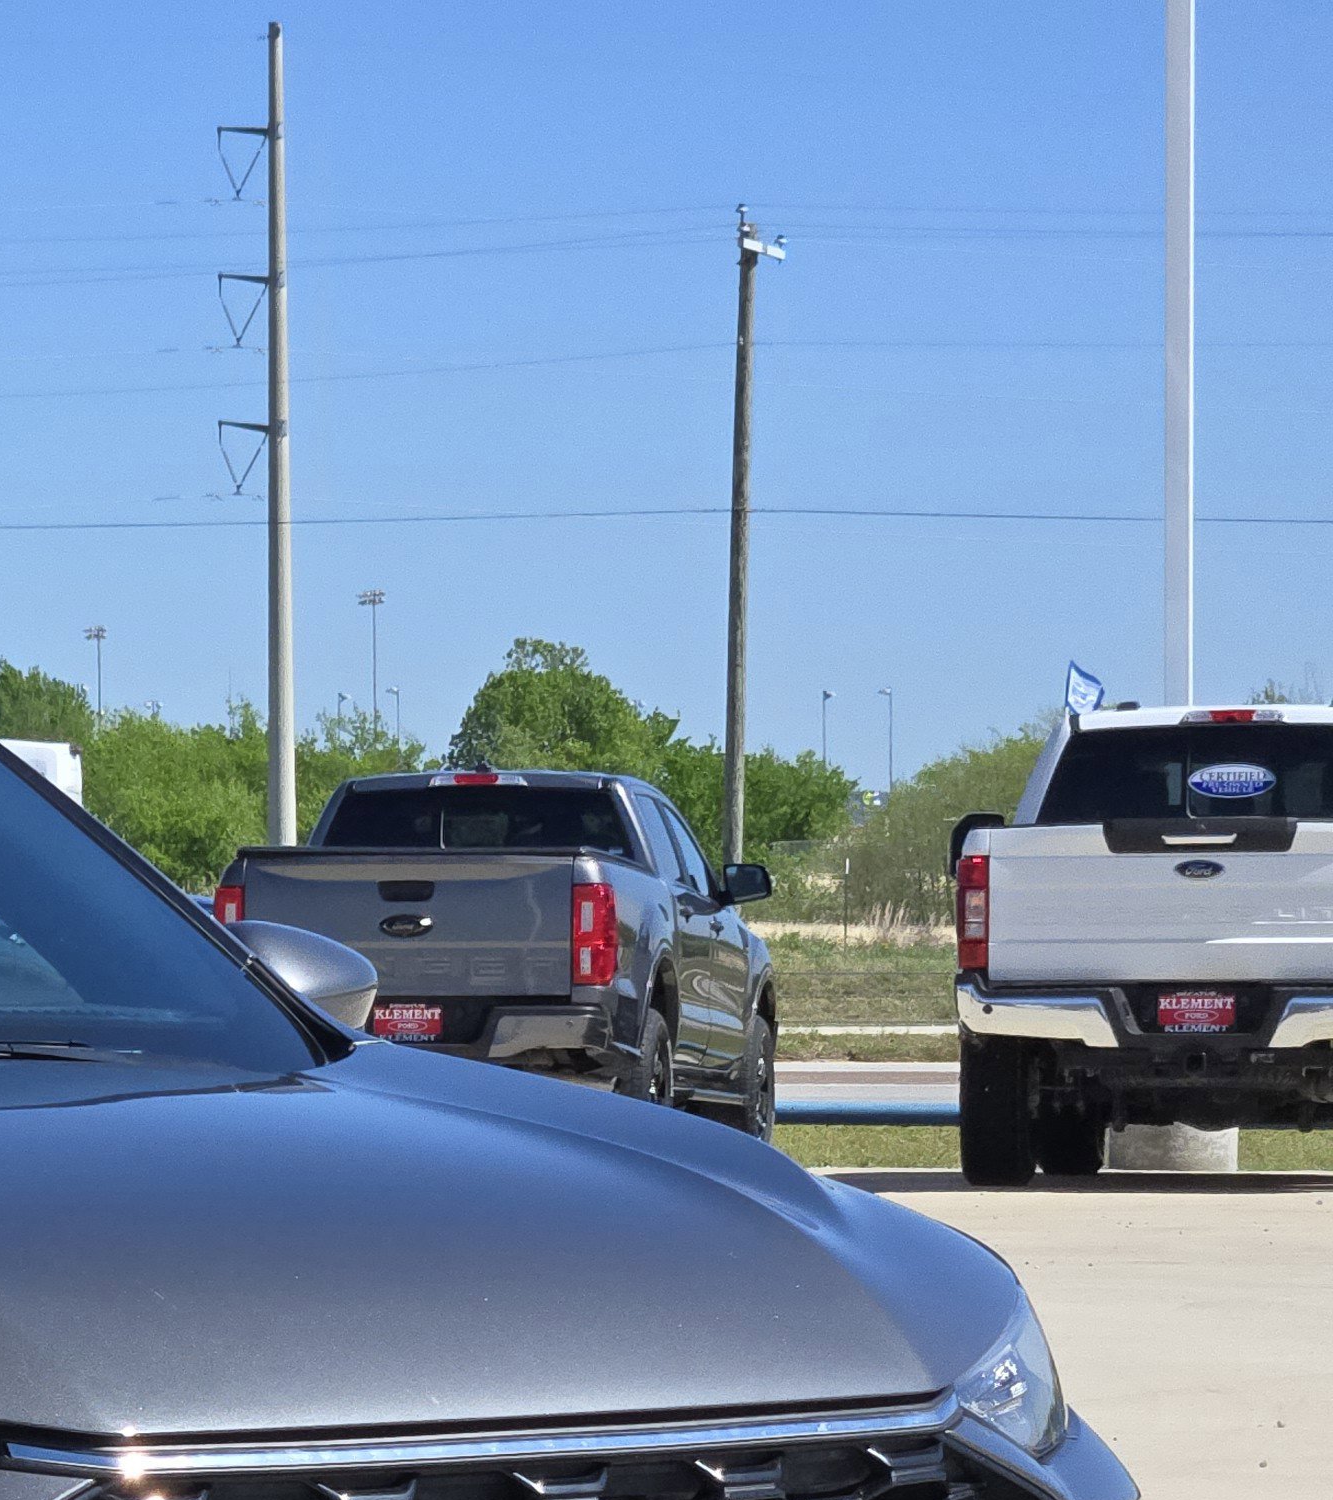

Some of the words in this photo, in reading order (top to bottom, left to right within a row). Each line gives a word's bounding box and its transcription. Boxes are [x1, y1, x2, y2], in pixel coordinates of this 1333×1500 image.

[1158, 998, 1235, 1009] KLEMENT
[373, 1008, 442, 1020] KLEMENT
[1163, 1024, 1229, 1033] KLEMENT
